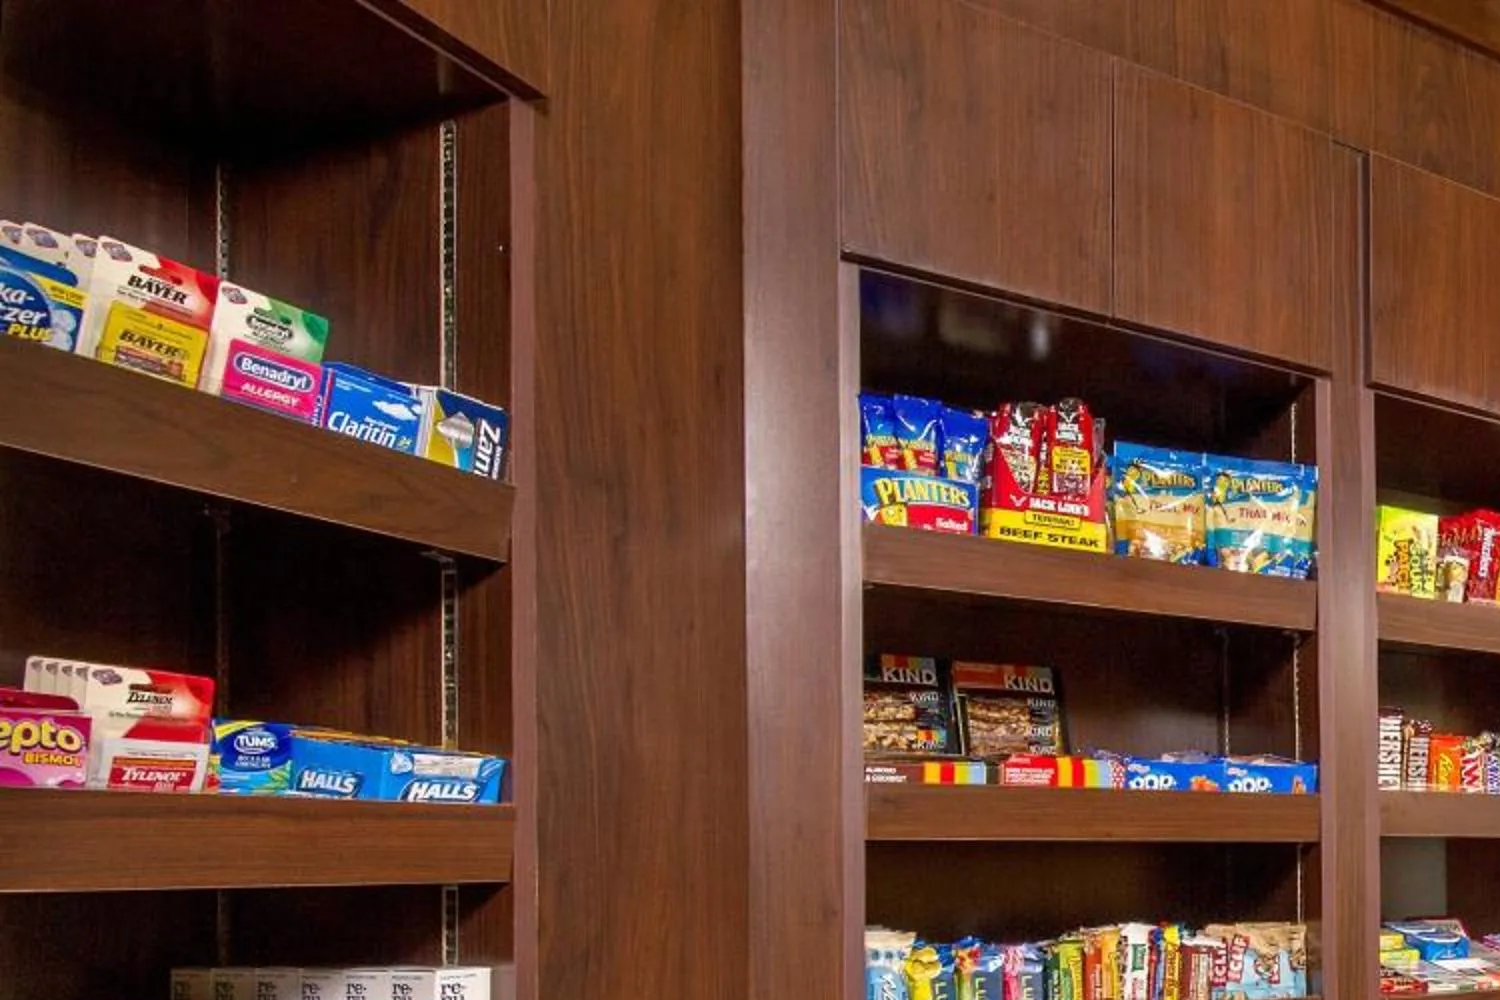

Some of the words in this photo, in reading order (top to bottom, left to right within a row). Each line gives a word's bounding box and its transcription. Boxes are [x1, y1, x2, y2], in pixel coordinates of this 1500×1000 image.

[127, 274, 189, 306] BAYER
[8, 324, 54, 342] PLUS
[119, 329, 183, 358] BAYER
[240, 357, 308, 390] Benadryl
[327, 411, 397, 449] Claritin
[875, 476, 971, 506] PLANTERS
[999, 527, 1044, 540] BEEF
[1047, 533, 1100, 549] STEAK
[881, 667, 939, 685] KIND
[1003, 676, 1055, 693] KIND
[127, 690, 173, 705] TYLENOL
[238, 735, 277, 748] TUMS
[121, 766, 183, 783] TYLENOL
[300, 769, 357, 793] HALLS
[405, 779, 478, 801] HALLS
